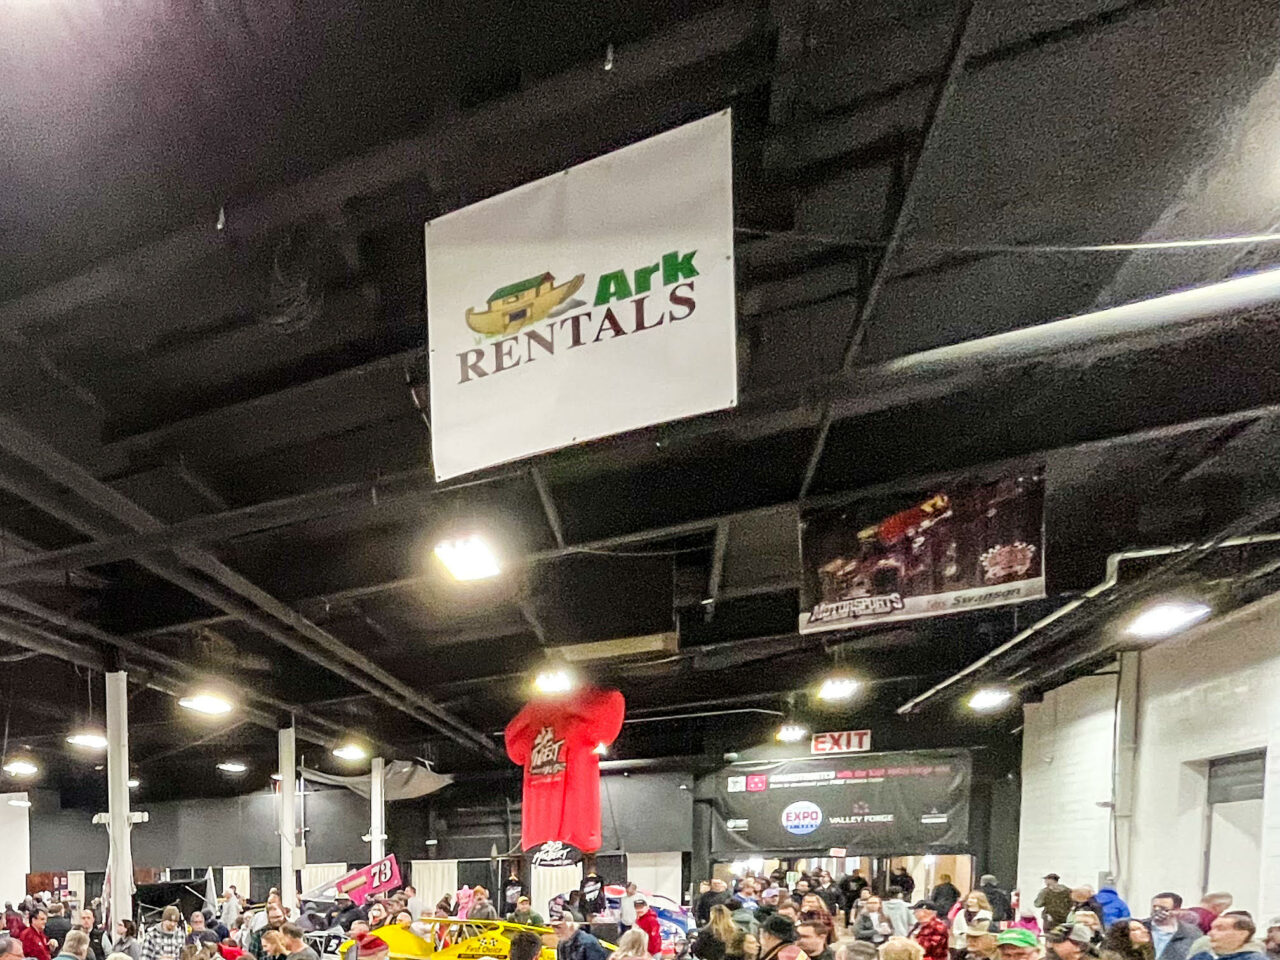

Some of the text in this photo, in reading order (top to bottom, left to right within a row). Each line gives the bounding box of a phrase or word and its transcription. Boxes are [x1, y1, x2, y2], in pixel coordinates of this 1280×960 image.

[593, 249, 700, 307] Ark
[456, 281, 696, 384] RENTALS
[813, 731, 869, 752] EXIT
[785, 810, 819, 822] EXPO
[370, 860, 393, 889] 73
